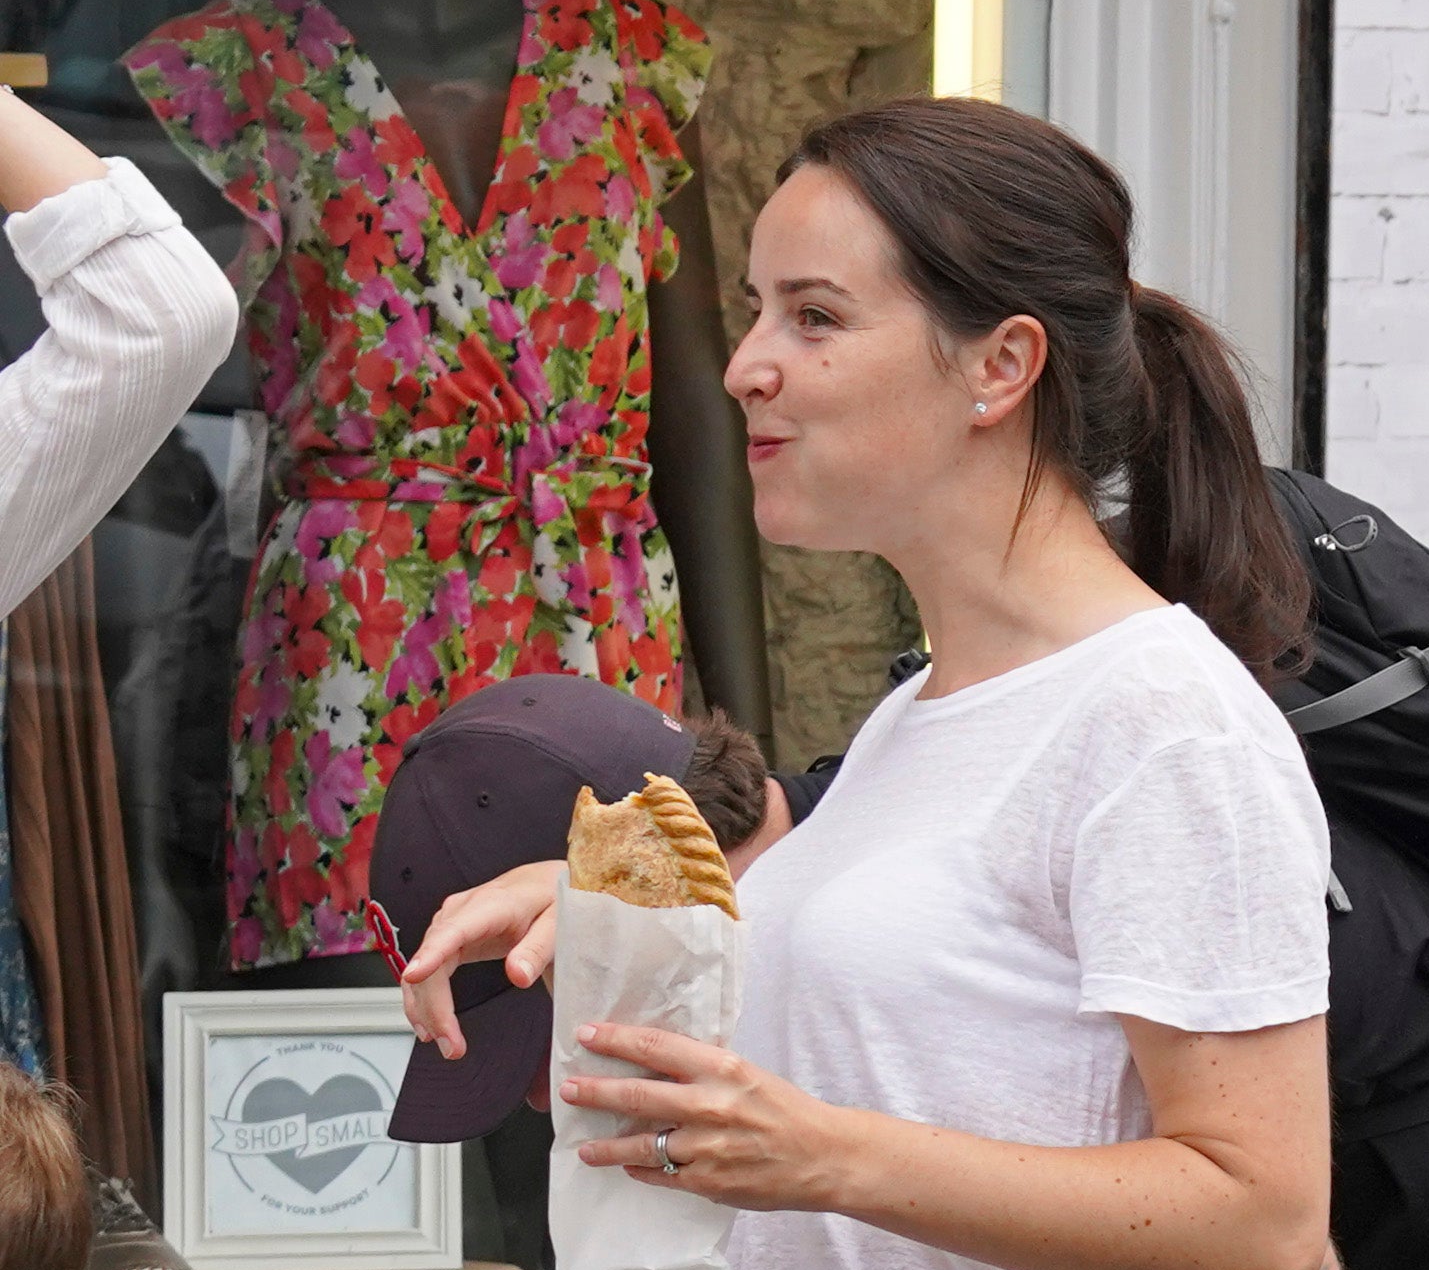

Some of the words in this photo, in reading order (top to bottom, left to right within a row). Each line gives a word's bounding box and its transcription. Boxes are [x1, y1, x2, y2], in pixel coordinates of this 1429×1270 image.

[276, 1043, 316, 1057] THANK
[321, 1042, 345, 1054] YOU
[235, 1121, 299, 1151] SHOP
